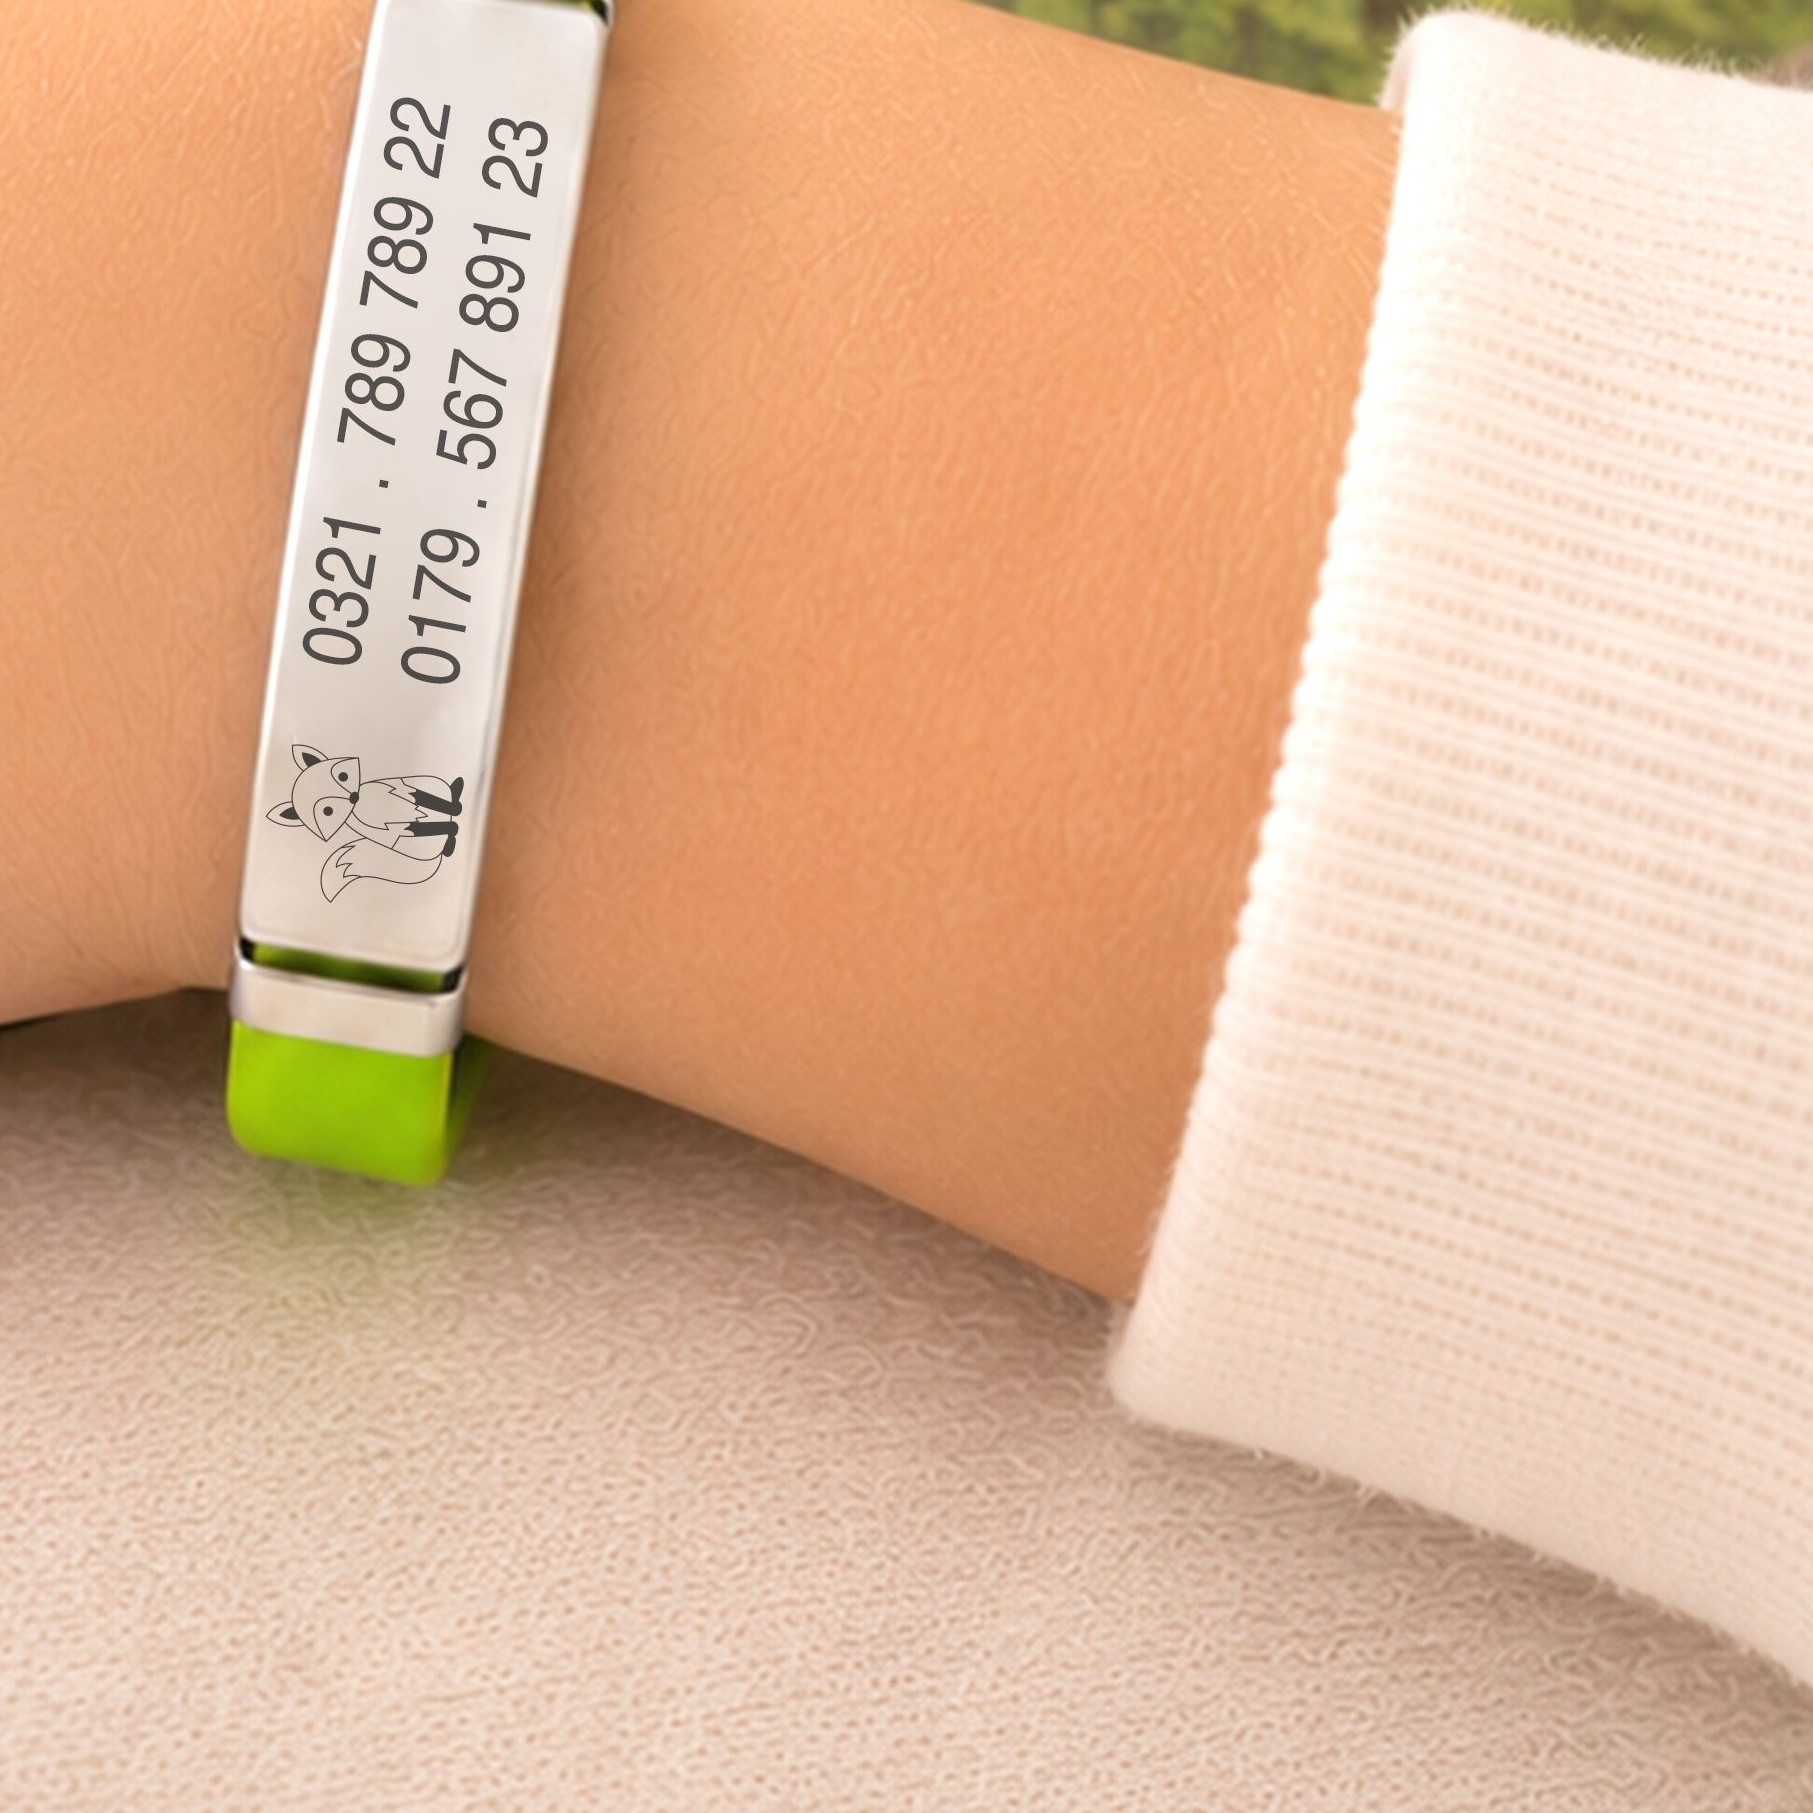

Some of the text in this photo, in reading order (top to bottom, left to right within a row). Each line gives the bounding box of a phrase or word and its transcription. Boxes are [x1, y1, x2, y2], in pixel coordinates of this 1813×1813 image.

[383, 97, 451, 179] 22
[481, 117, 549, 198] 23
[359, 196, 434, 309] 789
[458, 222, 531, 333] 891
[336, 333, 411, 446] 789
[435, 348, 508, 470] 567
[302, 516, 382, 666] 0321
[400, 528, 480, 685] 0179
